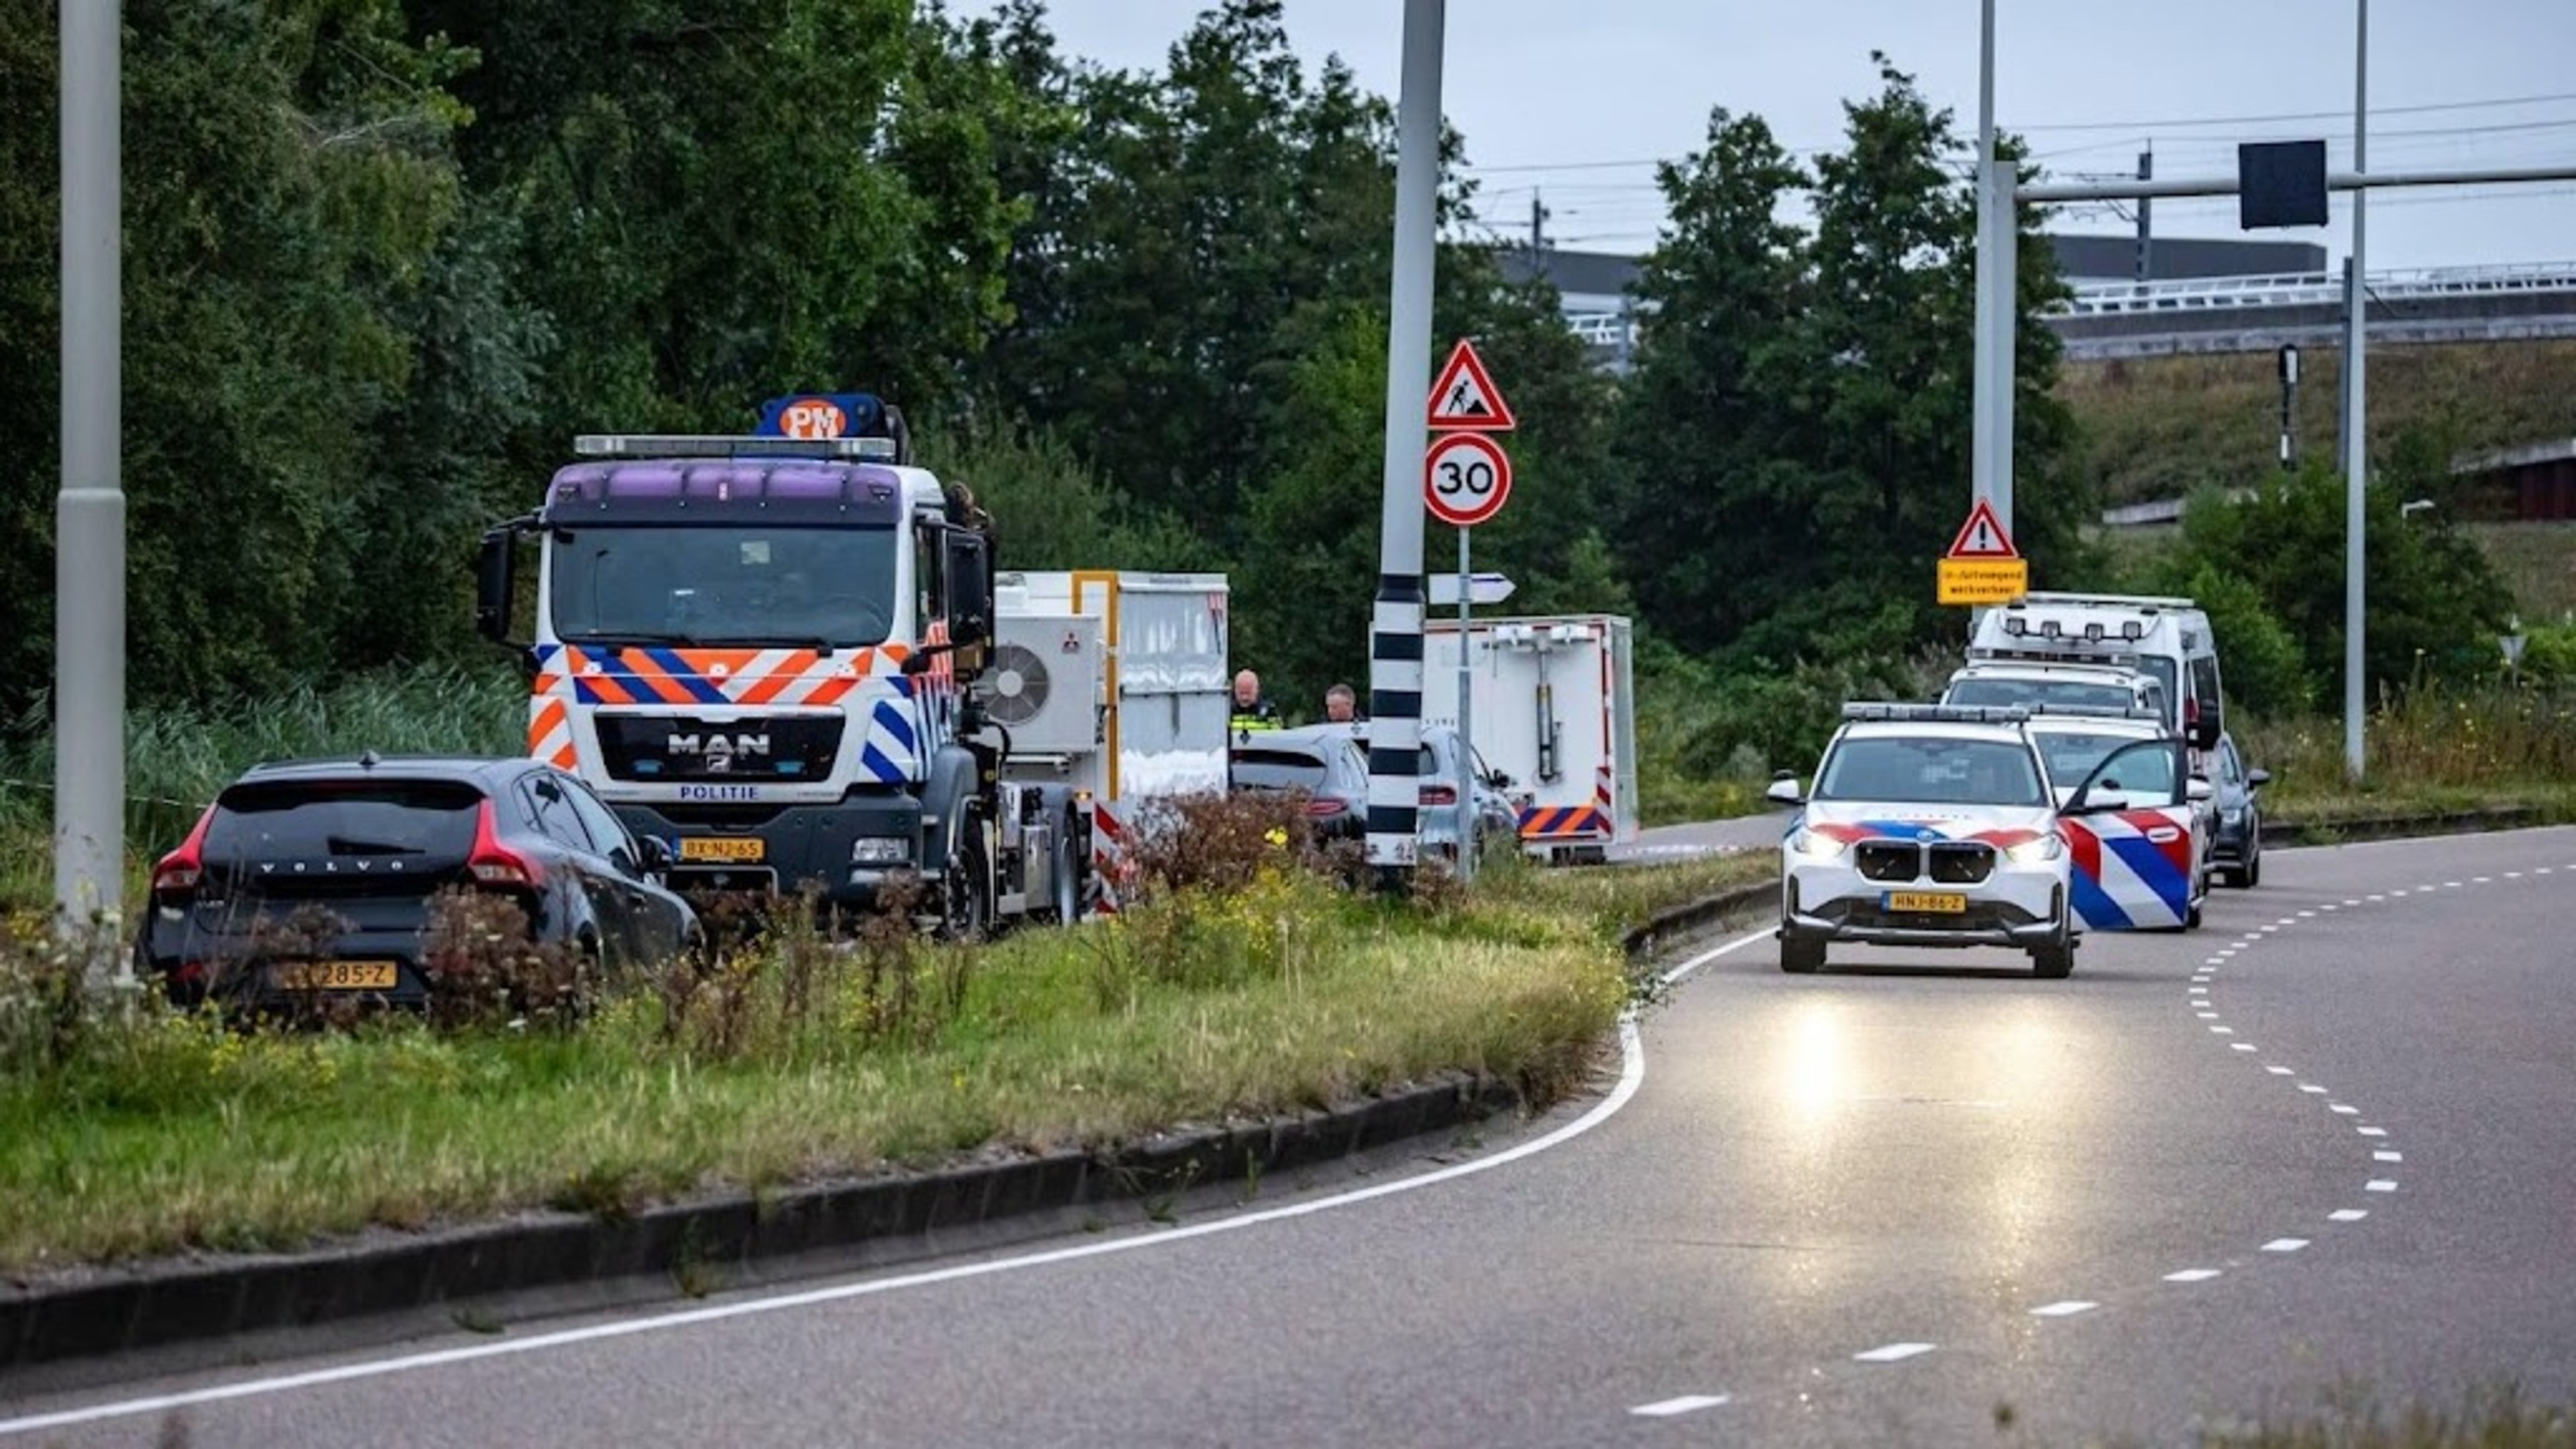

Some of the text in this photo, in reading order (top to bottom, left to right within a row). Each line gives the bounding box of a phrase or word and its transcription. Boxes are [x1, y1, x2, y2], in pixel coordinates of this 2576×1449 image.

[788, 407, 839, 438] PM
[1438, 462, 1493, 494] 30
[669, 734, 771, 755] MAN
[680, 786, 759, 799] POLITIE
[261, 861, 403, 873] VOLVO
